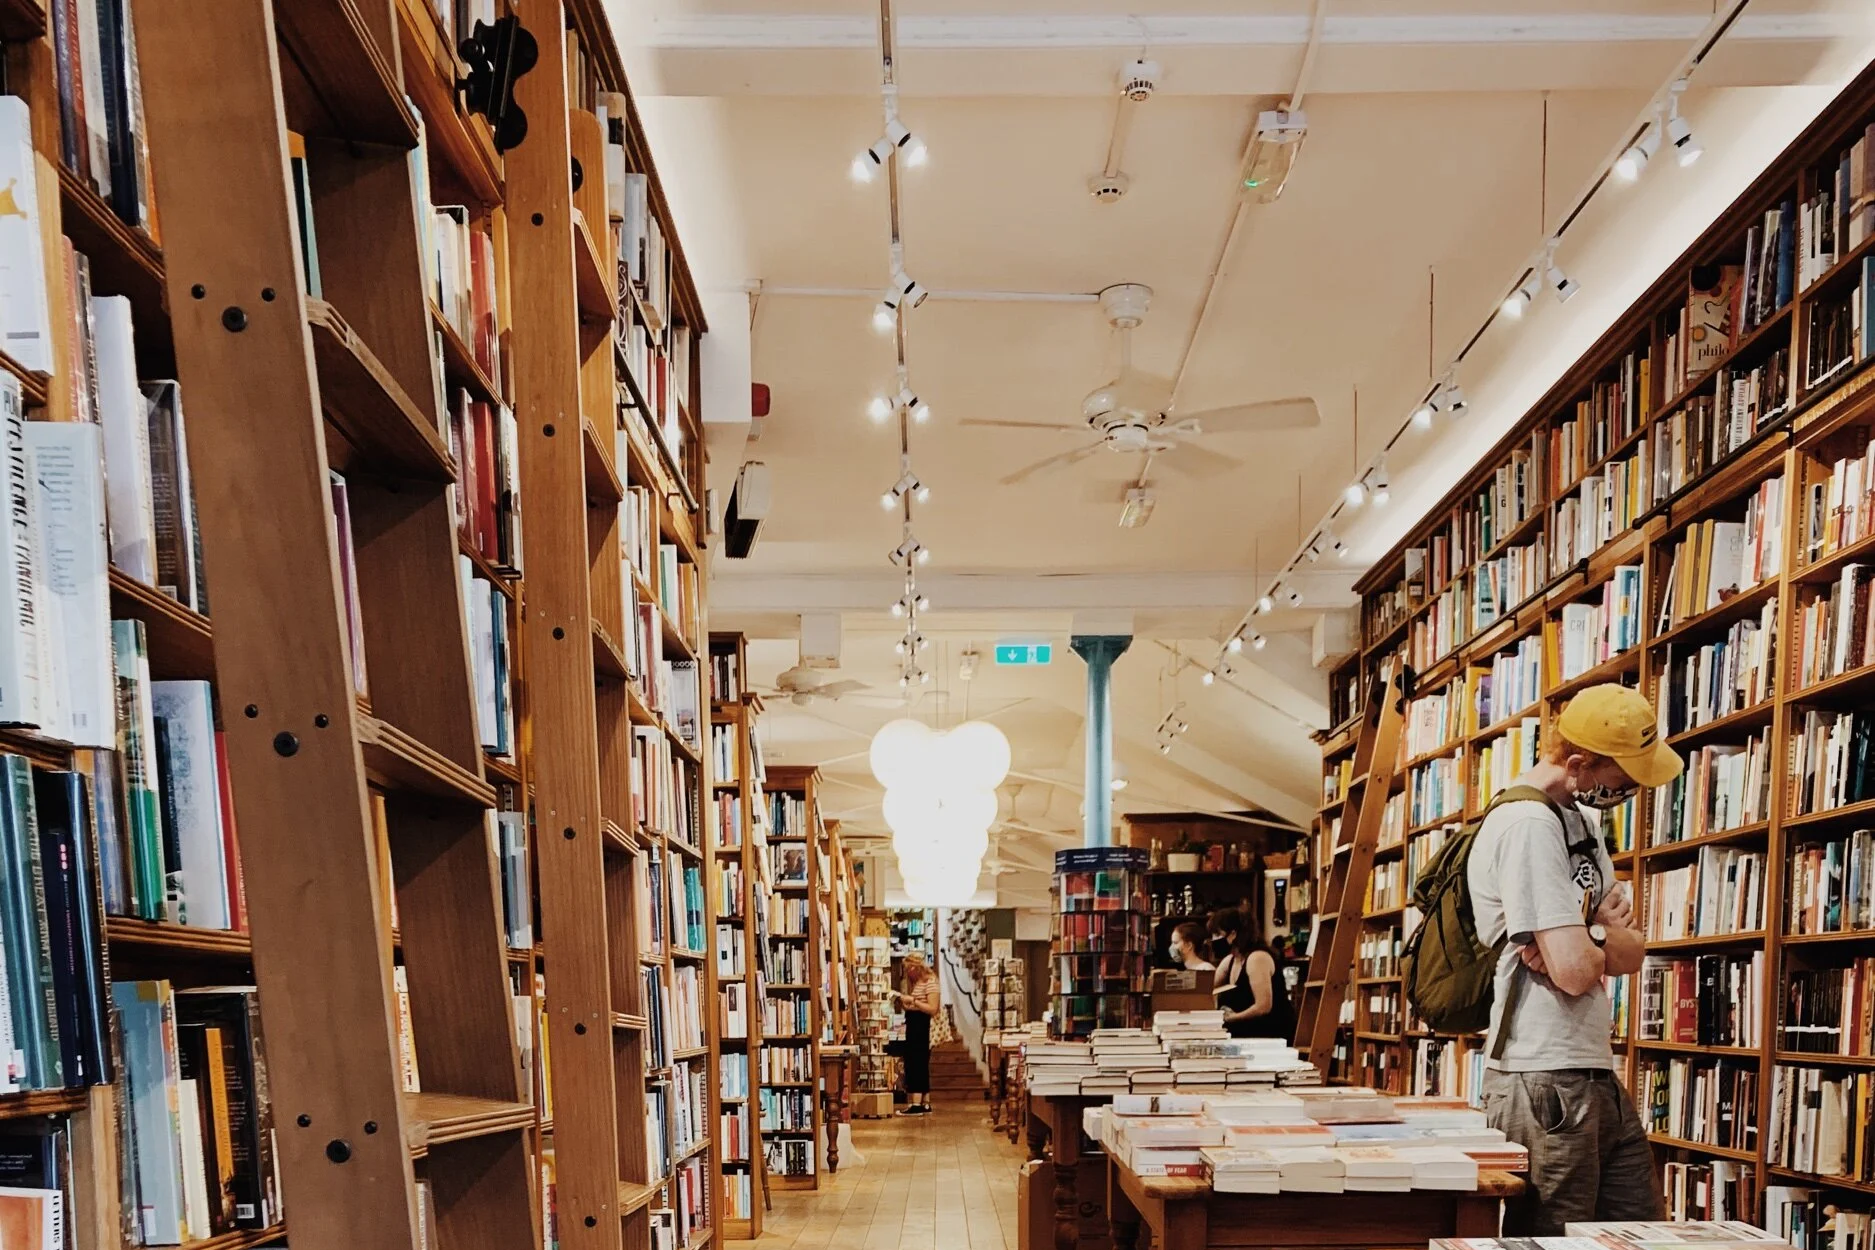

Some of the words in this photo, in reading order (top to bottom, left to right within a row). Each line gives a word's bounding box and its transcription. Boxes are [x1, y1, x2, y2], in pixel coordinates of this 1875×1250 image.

[1698, 344, 1730, 361] philo
[14, 543, 36, 627] PANDEMIC
[52, 1195, 60, 1244] LETTERS
